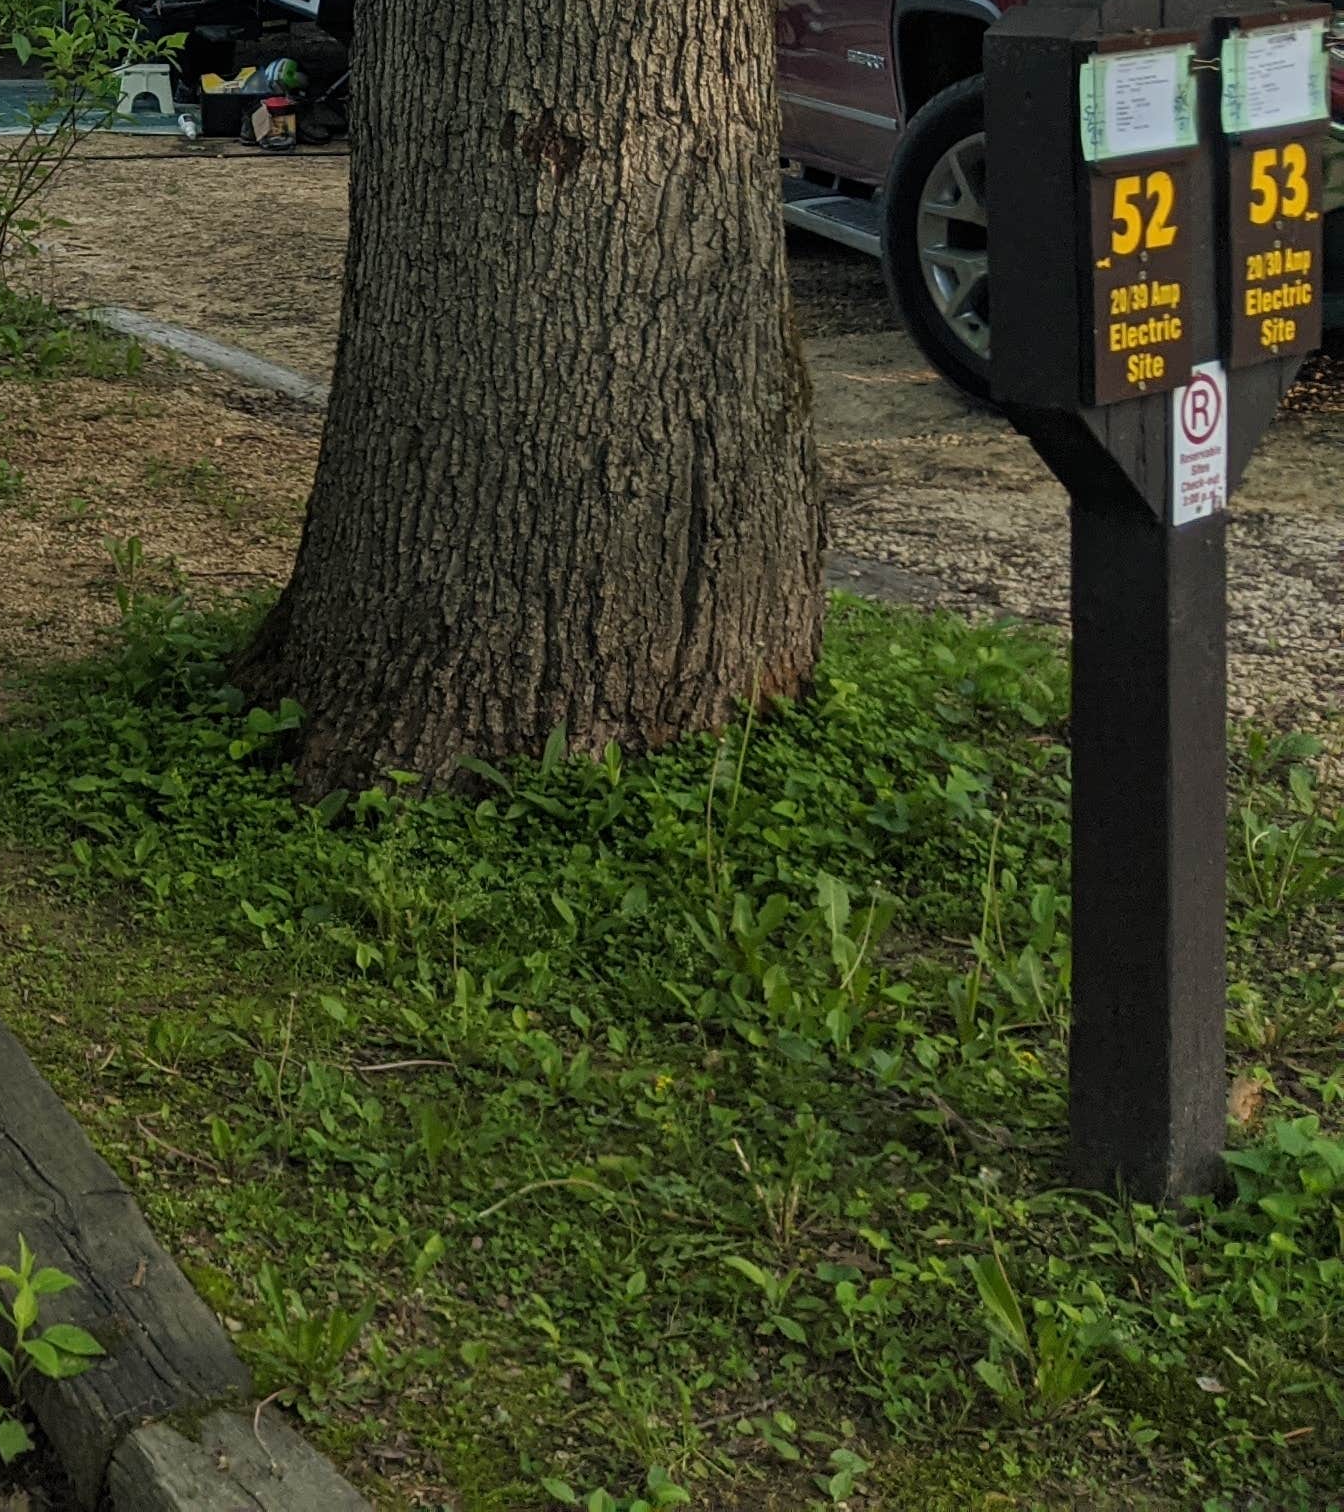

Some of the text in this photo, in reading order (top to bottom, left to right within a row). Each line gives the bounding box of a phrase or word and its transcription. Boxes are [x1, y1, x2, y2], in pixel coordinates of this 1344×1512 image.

[1249, 143, 1309, 225] 53
[1112, 170, 1178, 255] 52
[1246, 248, 1311, 280] 20/30 Amp
[1110, 280, 1181, 315] 20/30 Amp
[1245, 279, 1311, 316] Electric
[1109, 313, 1181, 352] Electric
[1261, 318, 1297, 347] Site
[1127, 354, 1164, 383] Site
[1191, 389, 1210, 430] R
